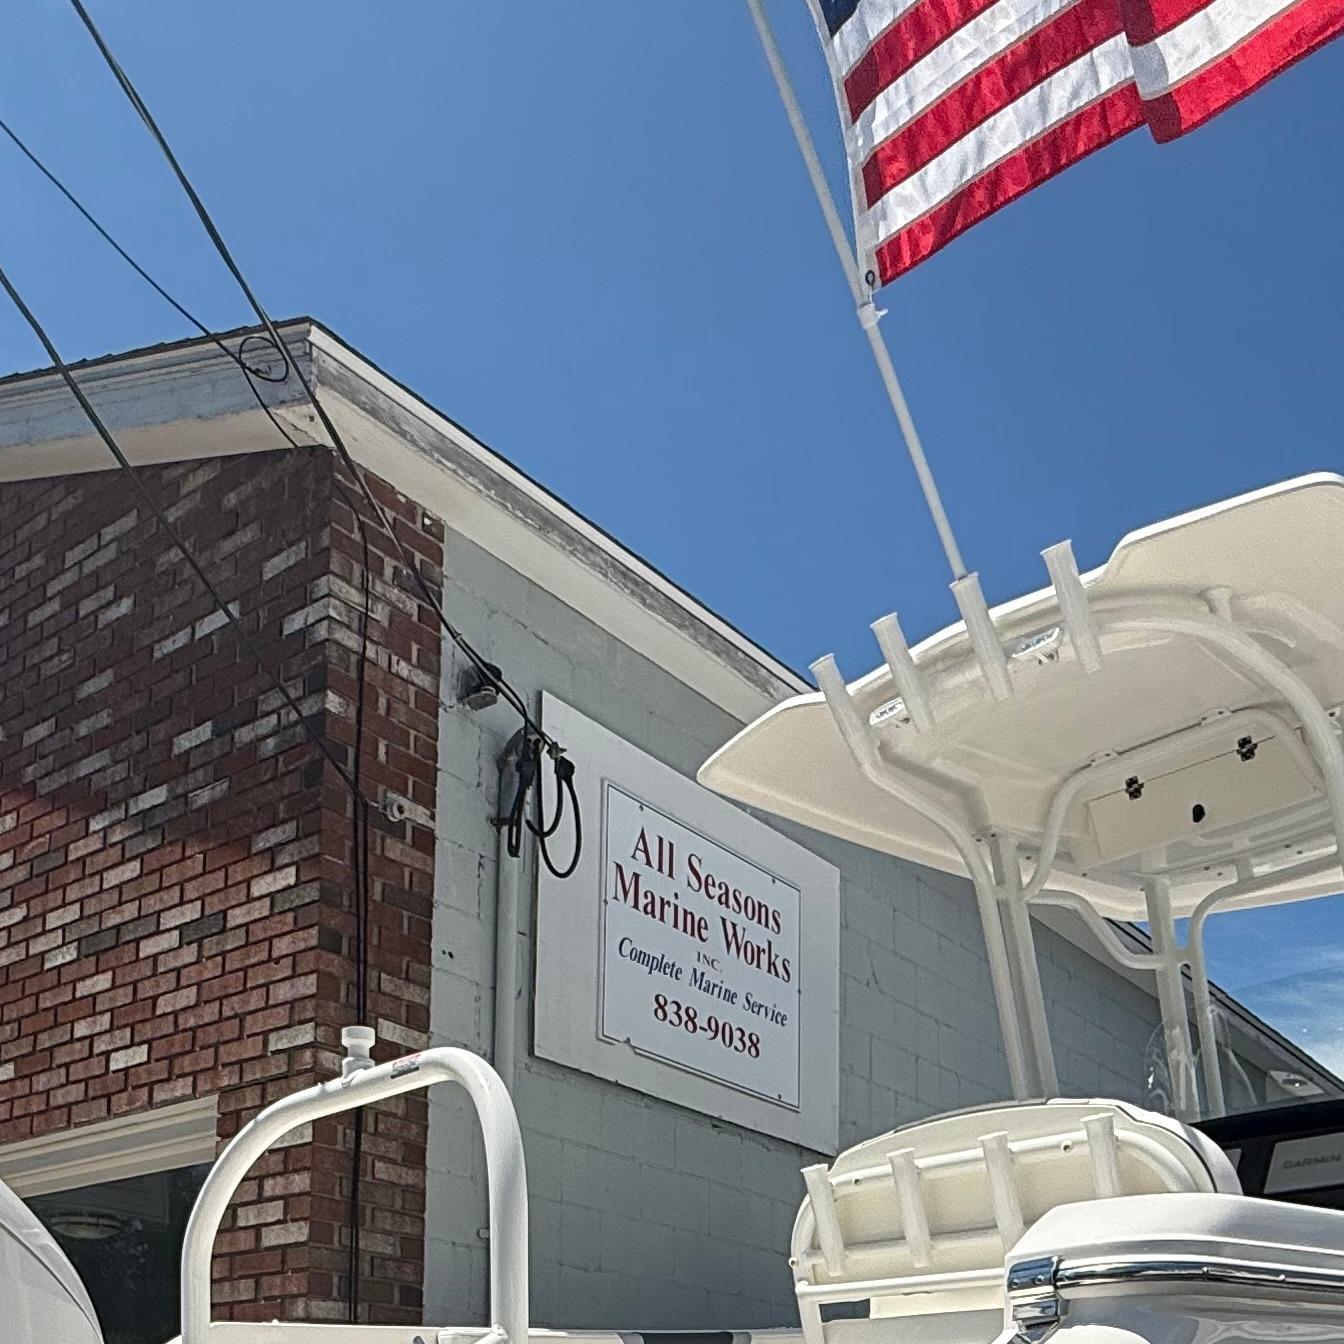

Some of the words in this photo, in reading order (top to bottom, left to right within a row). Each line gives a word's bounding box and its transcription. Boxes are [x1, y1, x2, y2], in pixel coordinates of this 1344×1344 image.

[612, 861, 709, 943] Marine
[720, 916, 792, 984] Works
[630, 826, 674, 881] All
[686, 853, 782, 936] Seasons
[618, 936, 683, 982] Complete
[689, 967, 738, 1007] Marine
[745, 991, 788, 1028] Service
[654, 993, 761, 1059] 838-9038
[1282, 1153, 1342, 1170] GARMIN
